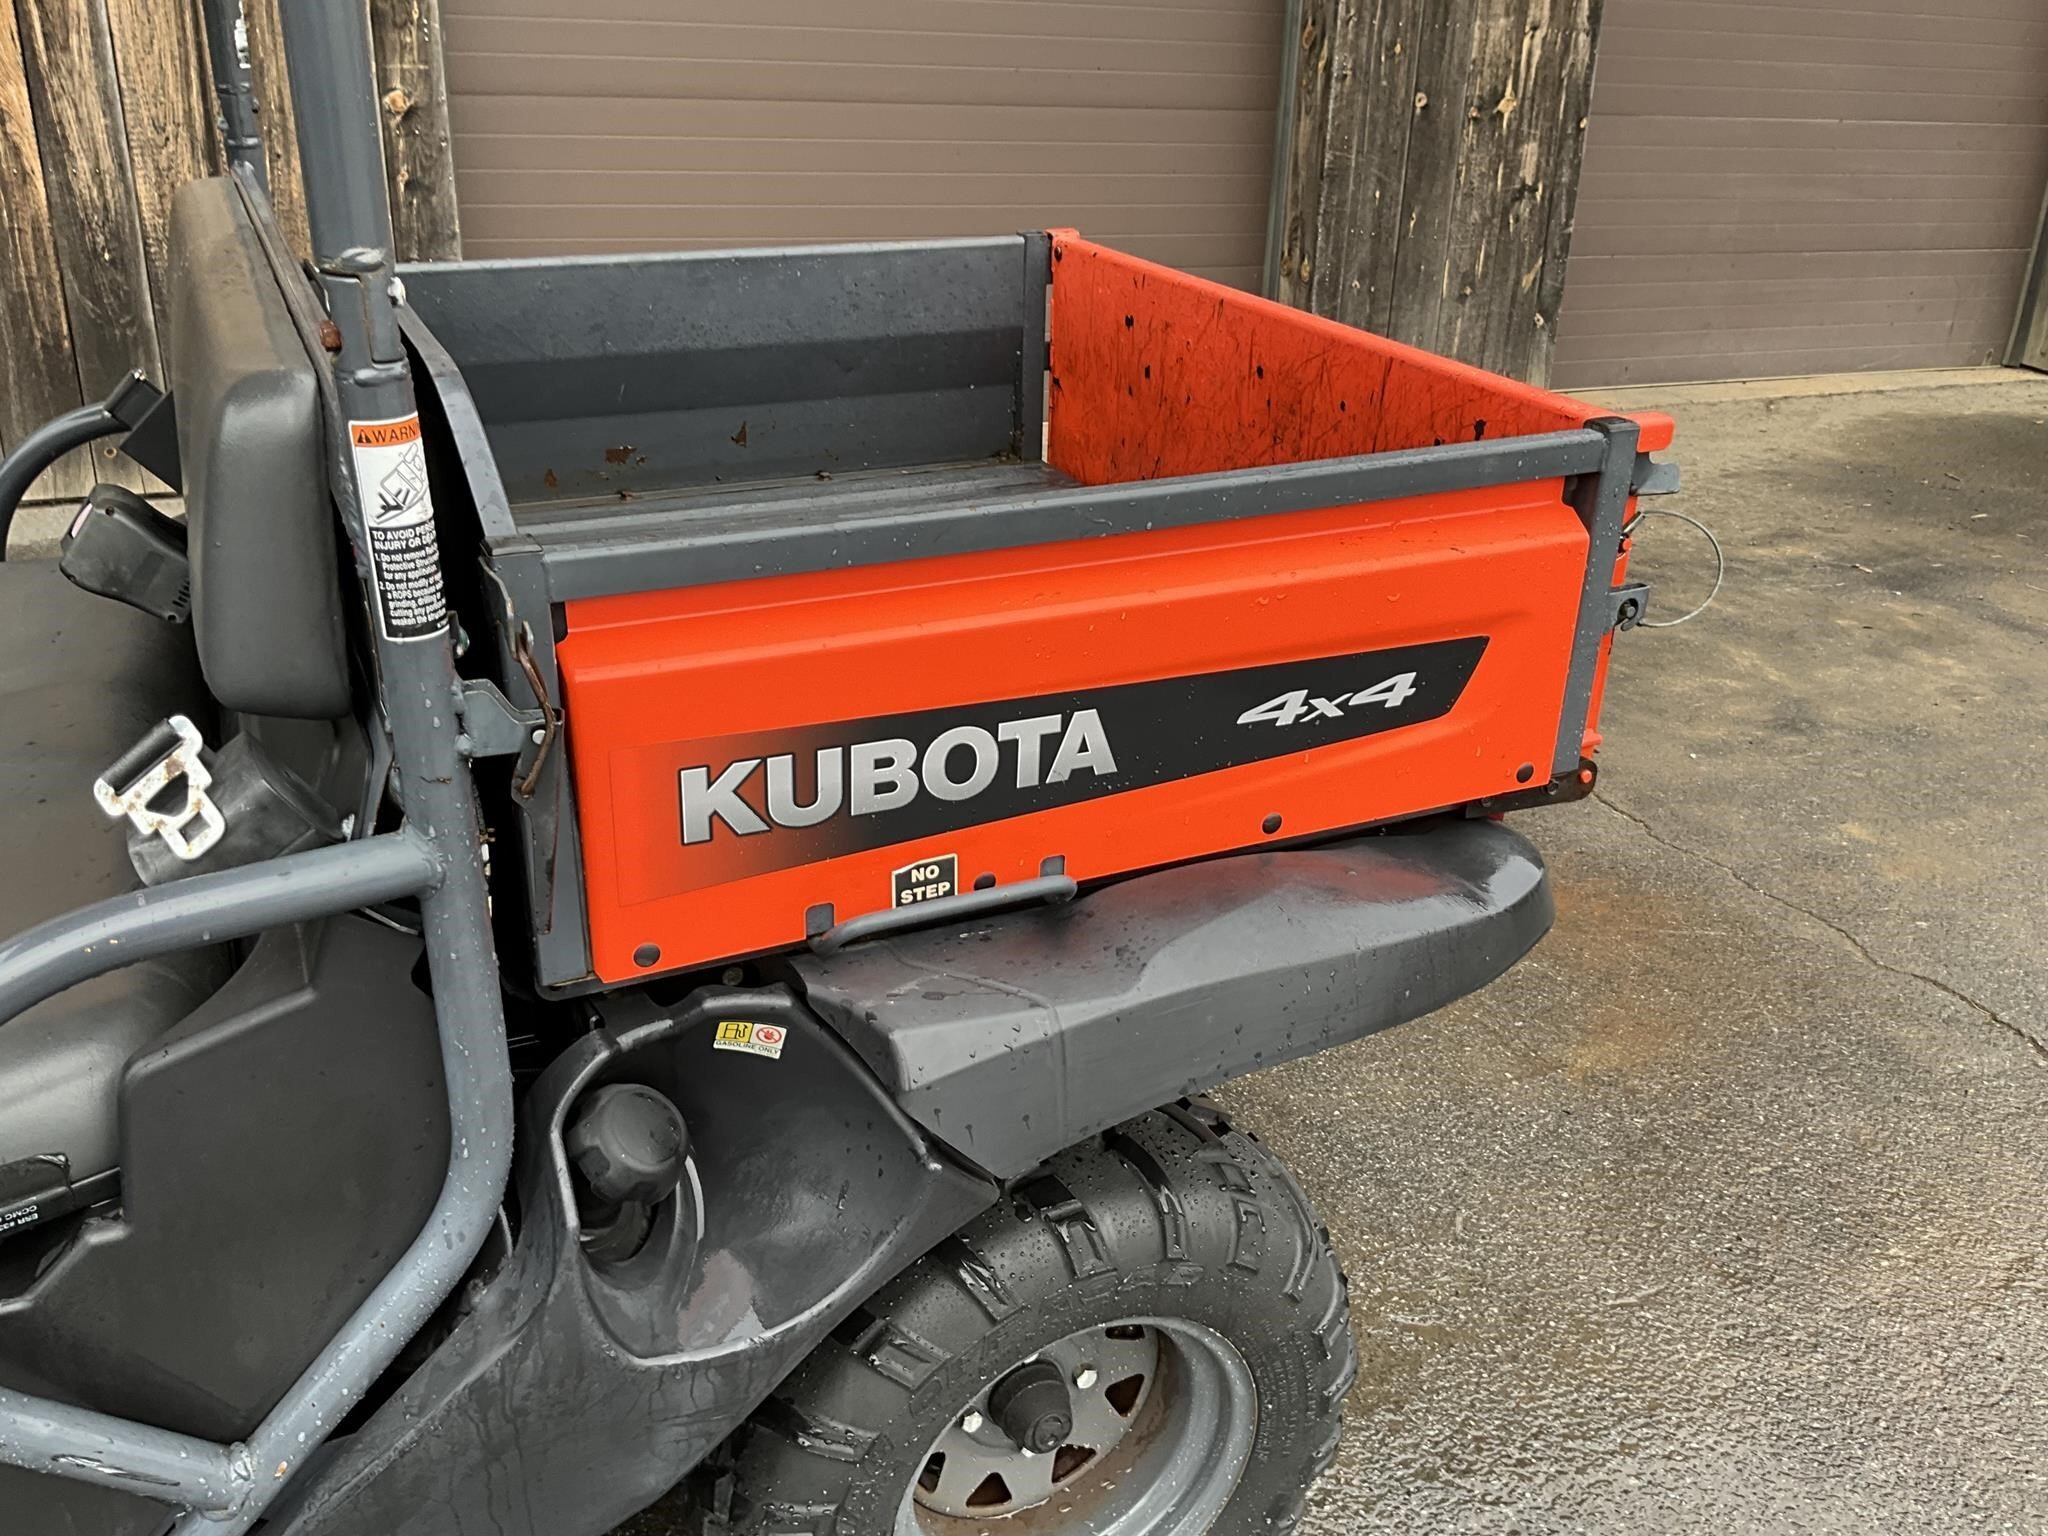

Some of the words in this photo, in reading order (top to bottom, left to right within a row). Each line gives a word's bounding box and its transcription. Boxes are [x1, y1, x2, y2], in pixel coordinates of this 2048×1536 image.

[371, 530, 385, 541] TO
[386, 528, 415, 541] AVOID
[374, 540, 407, 550] INJURY
[408, 537, 421, 548] OR
[392, 589, 413, 600] ROPS
[680, 708, 1119, 846] KUBOTA
[1236, 671, 1418, 728] 4x4
[911, 864, 940, 883] NO
[900, 880, 951, 904] STEP
[715, 1040, 756, 1050] GASOLINE
[758, 1046, 779, 1055] ONLY
